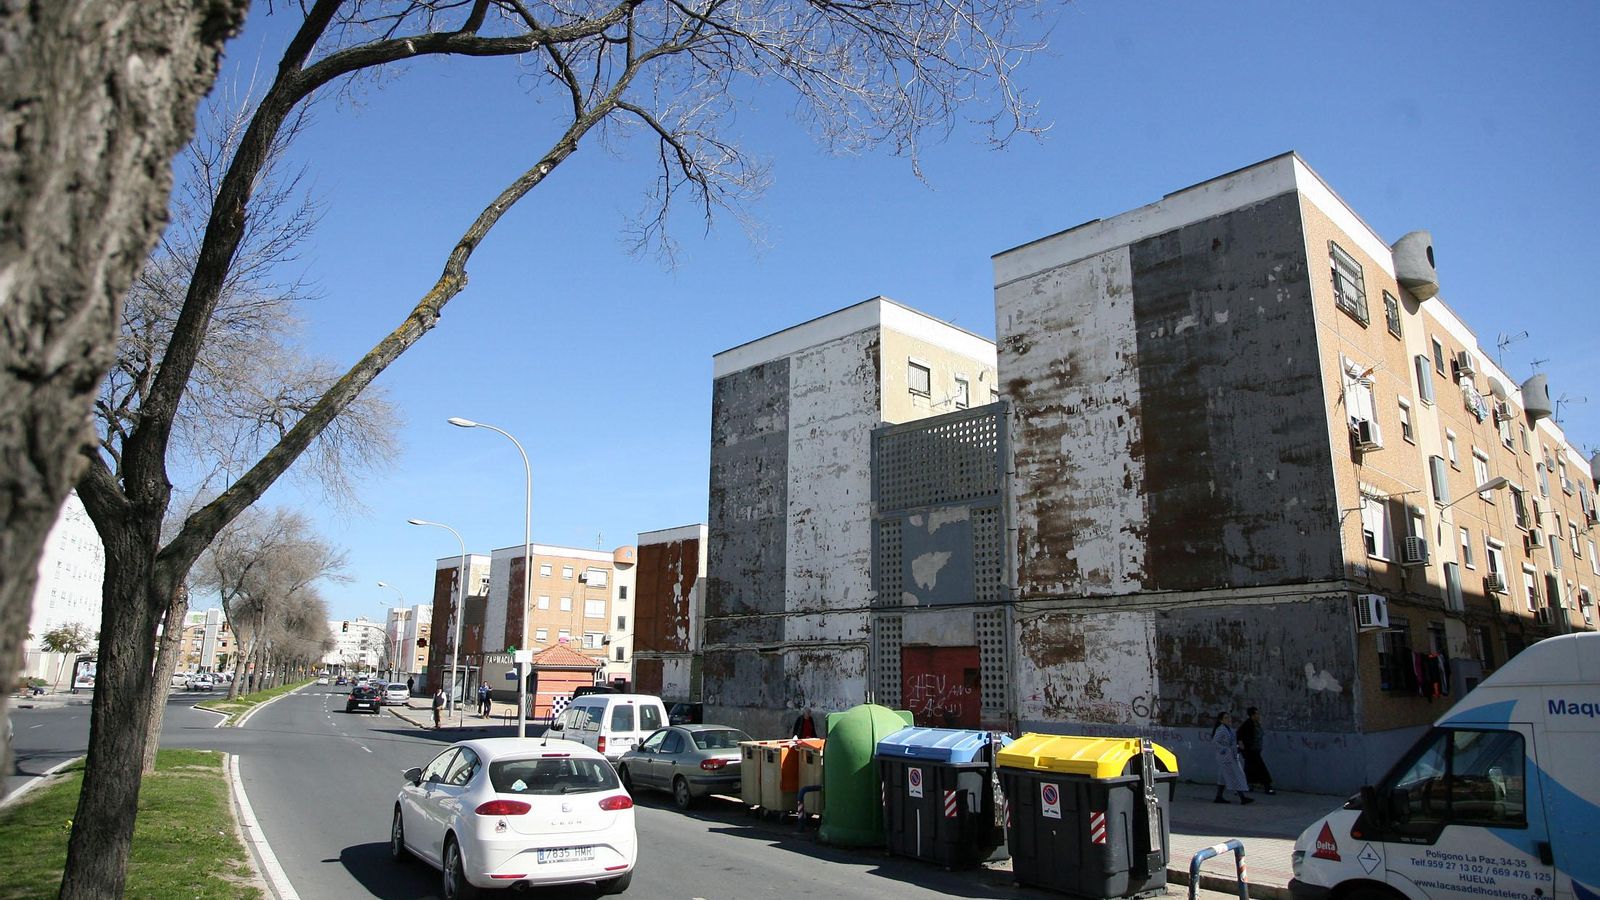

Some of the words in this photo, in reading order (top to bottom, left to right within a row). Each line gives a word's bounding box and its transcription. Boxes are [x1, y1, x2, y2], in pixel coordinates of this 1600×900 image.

[486, 655, 514, 664] FARMACIA
[1317, 840, 1336, 850] Delta
[546, 848, 570, 859] 7835
[574, 845, 592, 856] HMR
[1465, 854, 1476, 862] La
[1479, 855, 1499, 866] Paz,
[1500, 857, 1527, 868] 34-35
[1446, 862, 1456, 870] 27
[1460, 864, 1469, 872] 13
[1471, 865, 1483, 873] 02
[1492, 867, 1510, 877] 669
[1513, 870, 1531, 879] 476
[1533, 872, 1552, 881] 125
[1459, 874, 1496, 885] HUELVA
